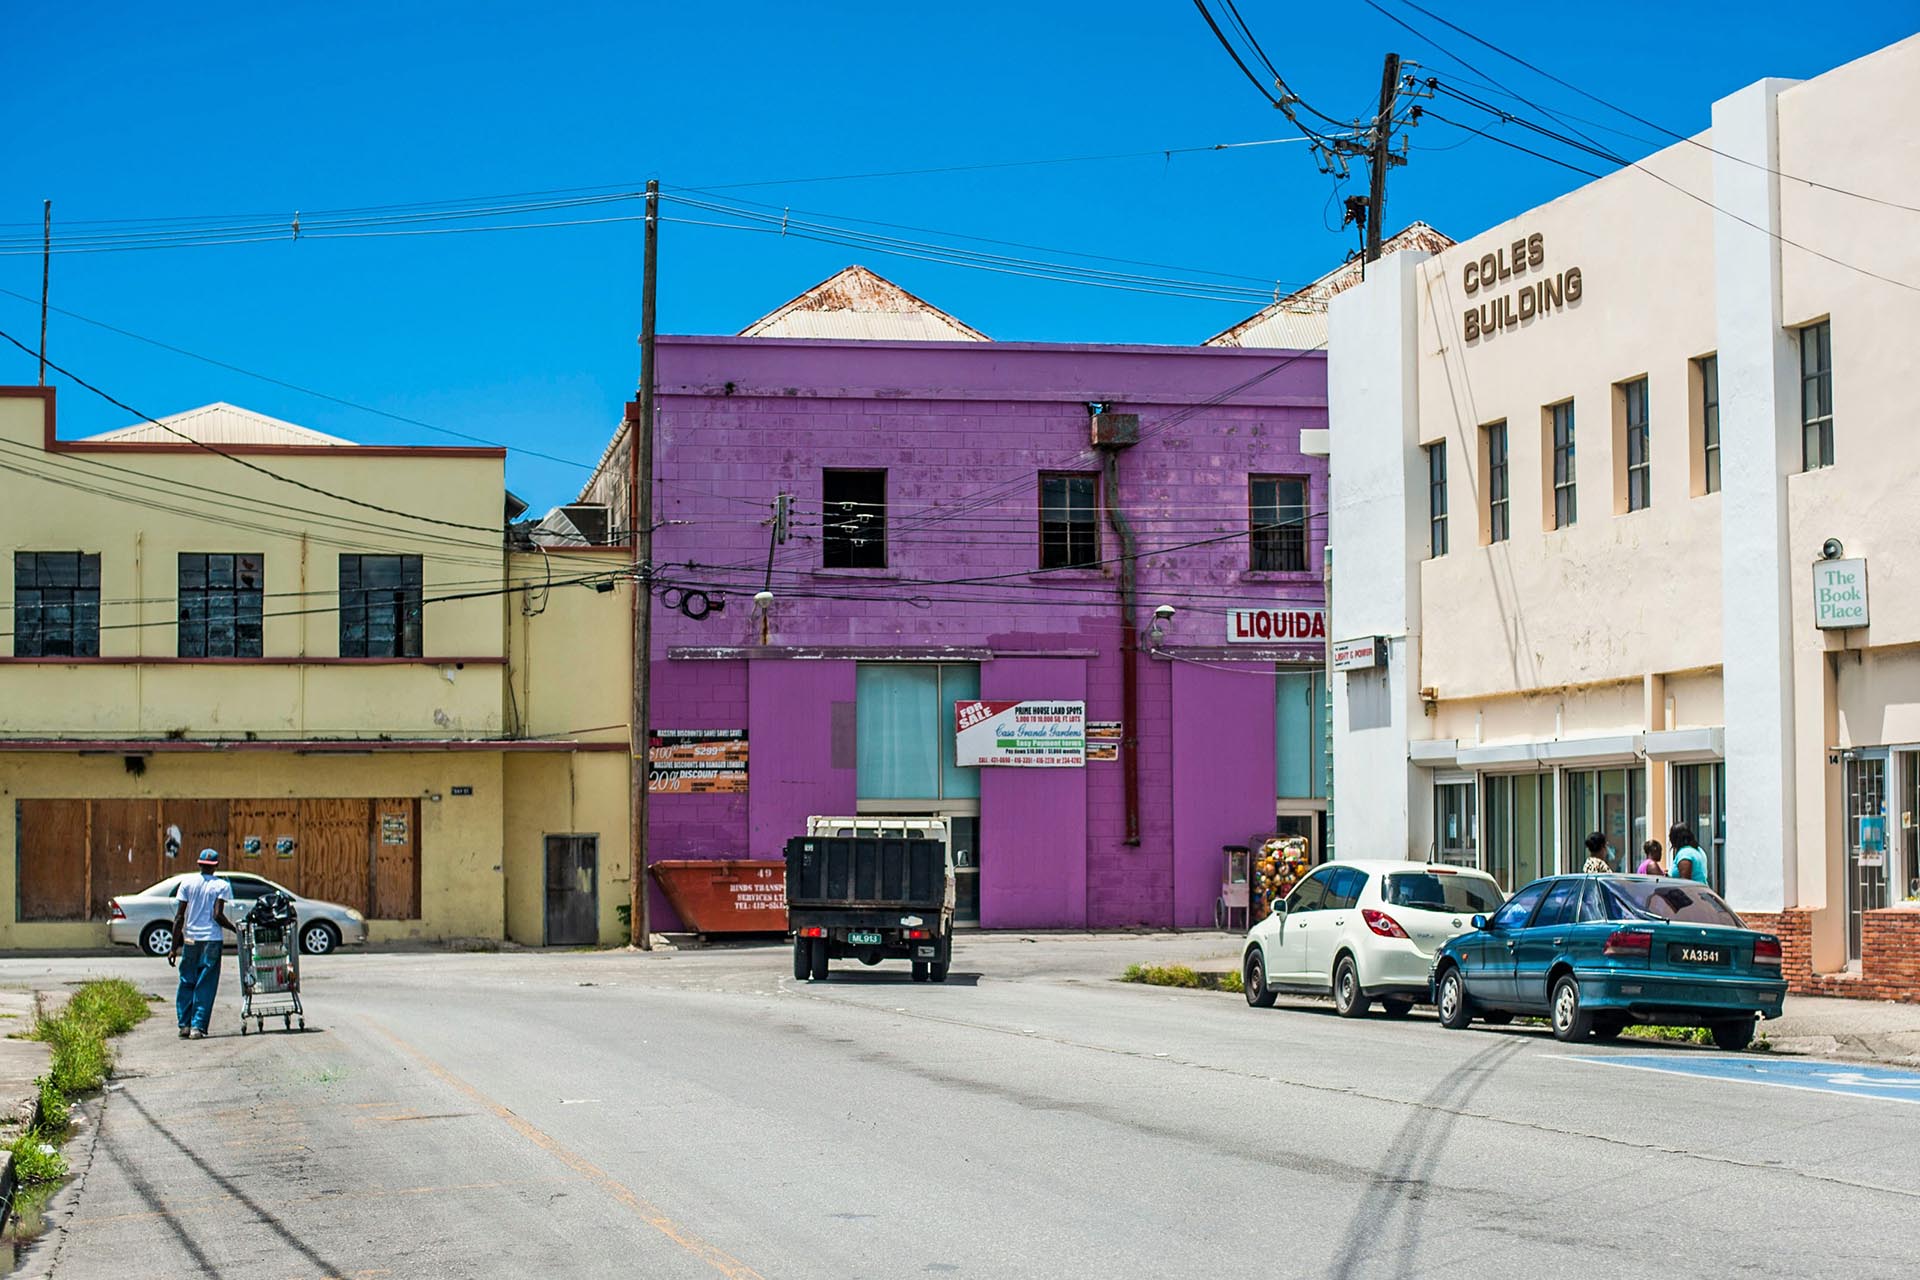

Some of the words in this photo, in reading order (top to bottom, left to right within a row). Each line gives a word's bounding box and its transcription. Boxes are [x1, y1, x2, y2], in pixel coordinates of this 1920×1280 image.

[1464, 232, 1544, 294] COLES
[1464, 267, 1582, 342] BUILDING
[1825, 570, 1855, 585] The
[1820, 586, 1861, 602] Book
[1820, 603, 1862, 619] Place
[1236, 610, 1326, 640] LIQUIDA
[960, 702, 983, 718] FOR
[1015, 706, 1032, 715] PRIME
[1034, 706, 1050, 715] HOUSE
[1050, 706, 1065, 715] LAND
[1065, 706, 1082, 715] SPOTS
[959, 706, 993, 729] SALE
[657, 729, 677, 737] MASSIVE
[996, 723, 1014, 737] Casa
[1017, 723, 1047, 737] Grande
[1049, 723, 1081, 737] Gardens
[1829, 755, 1838, 764] 14
[649, 771, 680, 791] 20%
[680, 770, 718, 778] DISCOUNT
[757, 869, 772, 878] 49
[730, 884, 753, 892] HINDS
[852, 934, 878, 943] ML913
[1682, 948, 1719, 962] XA3541
